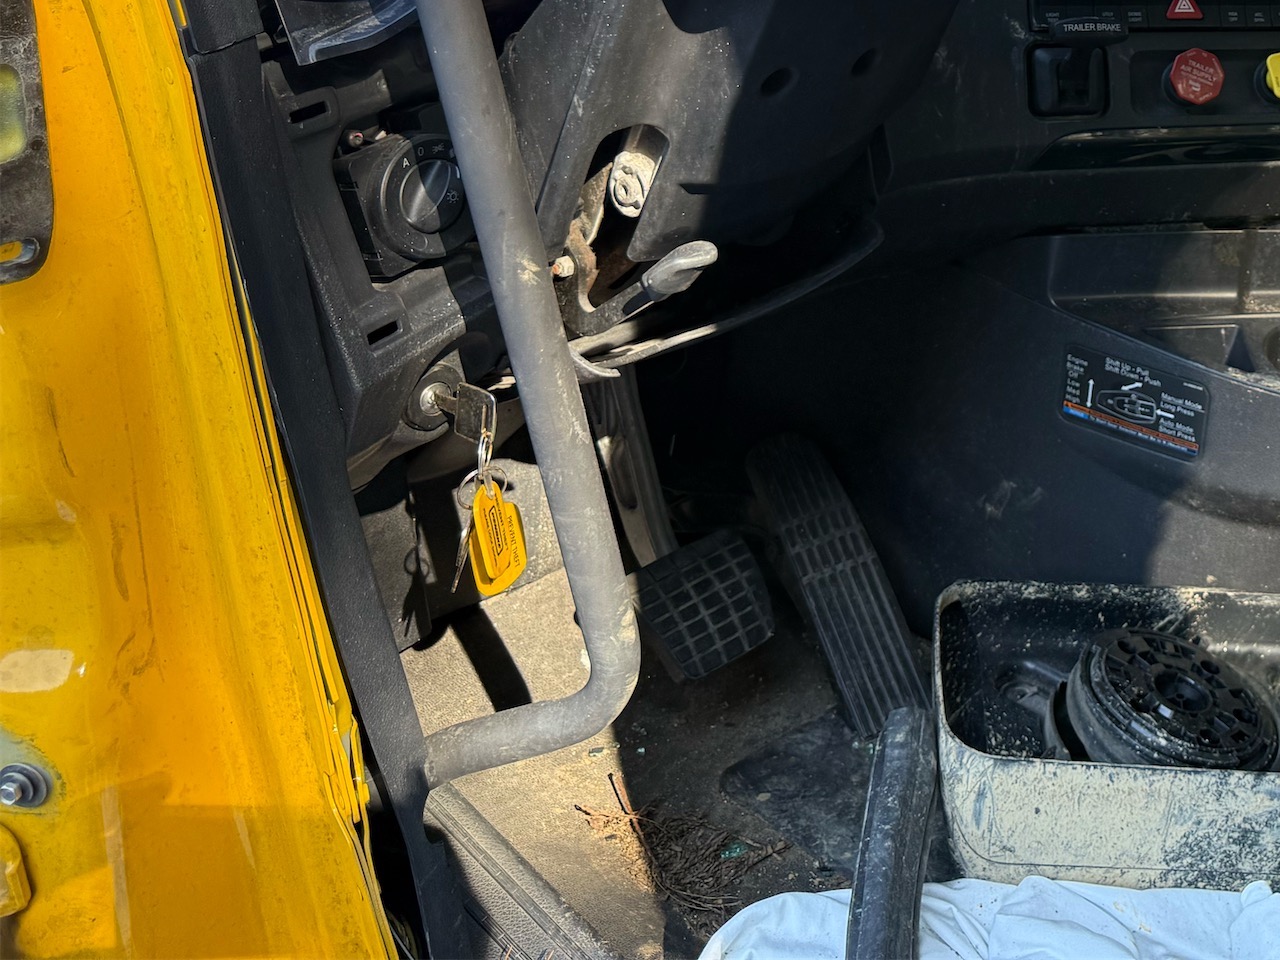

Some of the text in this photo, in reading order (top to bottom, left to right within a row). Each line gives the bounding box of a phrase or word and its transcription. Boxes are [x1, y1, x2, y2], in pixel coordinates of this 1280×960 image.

[1063, 23, 1121, 32] TRAILER BRAKE
[1180, 64, 1193, 73] AIR
[1194, 68, 1217, 82] SUPPLY
[1188, 59, 1214, 73] TRAILER
[402, 157, 410, 168] A
[1066, 353, 1088, 367] Engine
[1066, 361, 1085, 373] Brake
[1105, 357, 1121, 368] Shift
[1121, 361, 1132, 371] Up
[1136, 366, 1150, 376] Pull
[1067, 378, 1080, 387] Low
[1104, 363, 1120, 374] Shift
[1120, 369, 1139, 380] Down
[1144, 375, 1162, 387] Push
[1160, 392, 1203, 410] Manual Mode
[1160, 401, 1195, 417] Long Press
[1159, 418, 1194, 433] Auto Mode
[1158, 425, 1196, 442] Short Press
[507, 515, 521, 568] PREVENT THEFT
